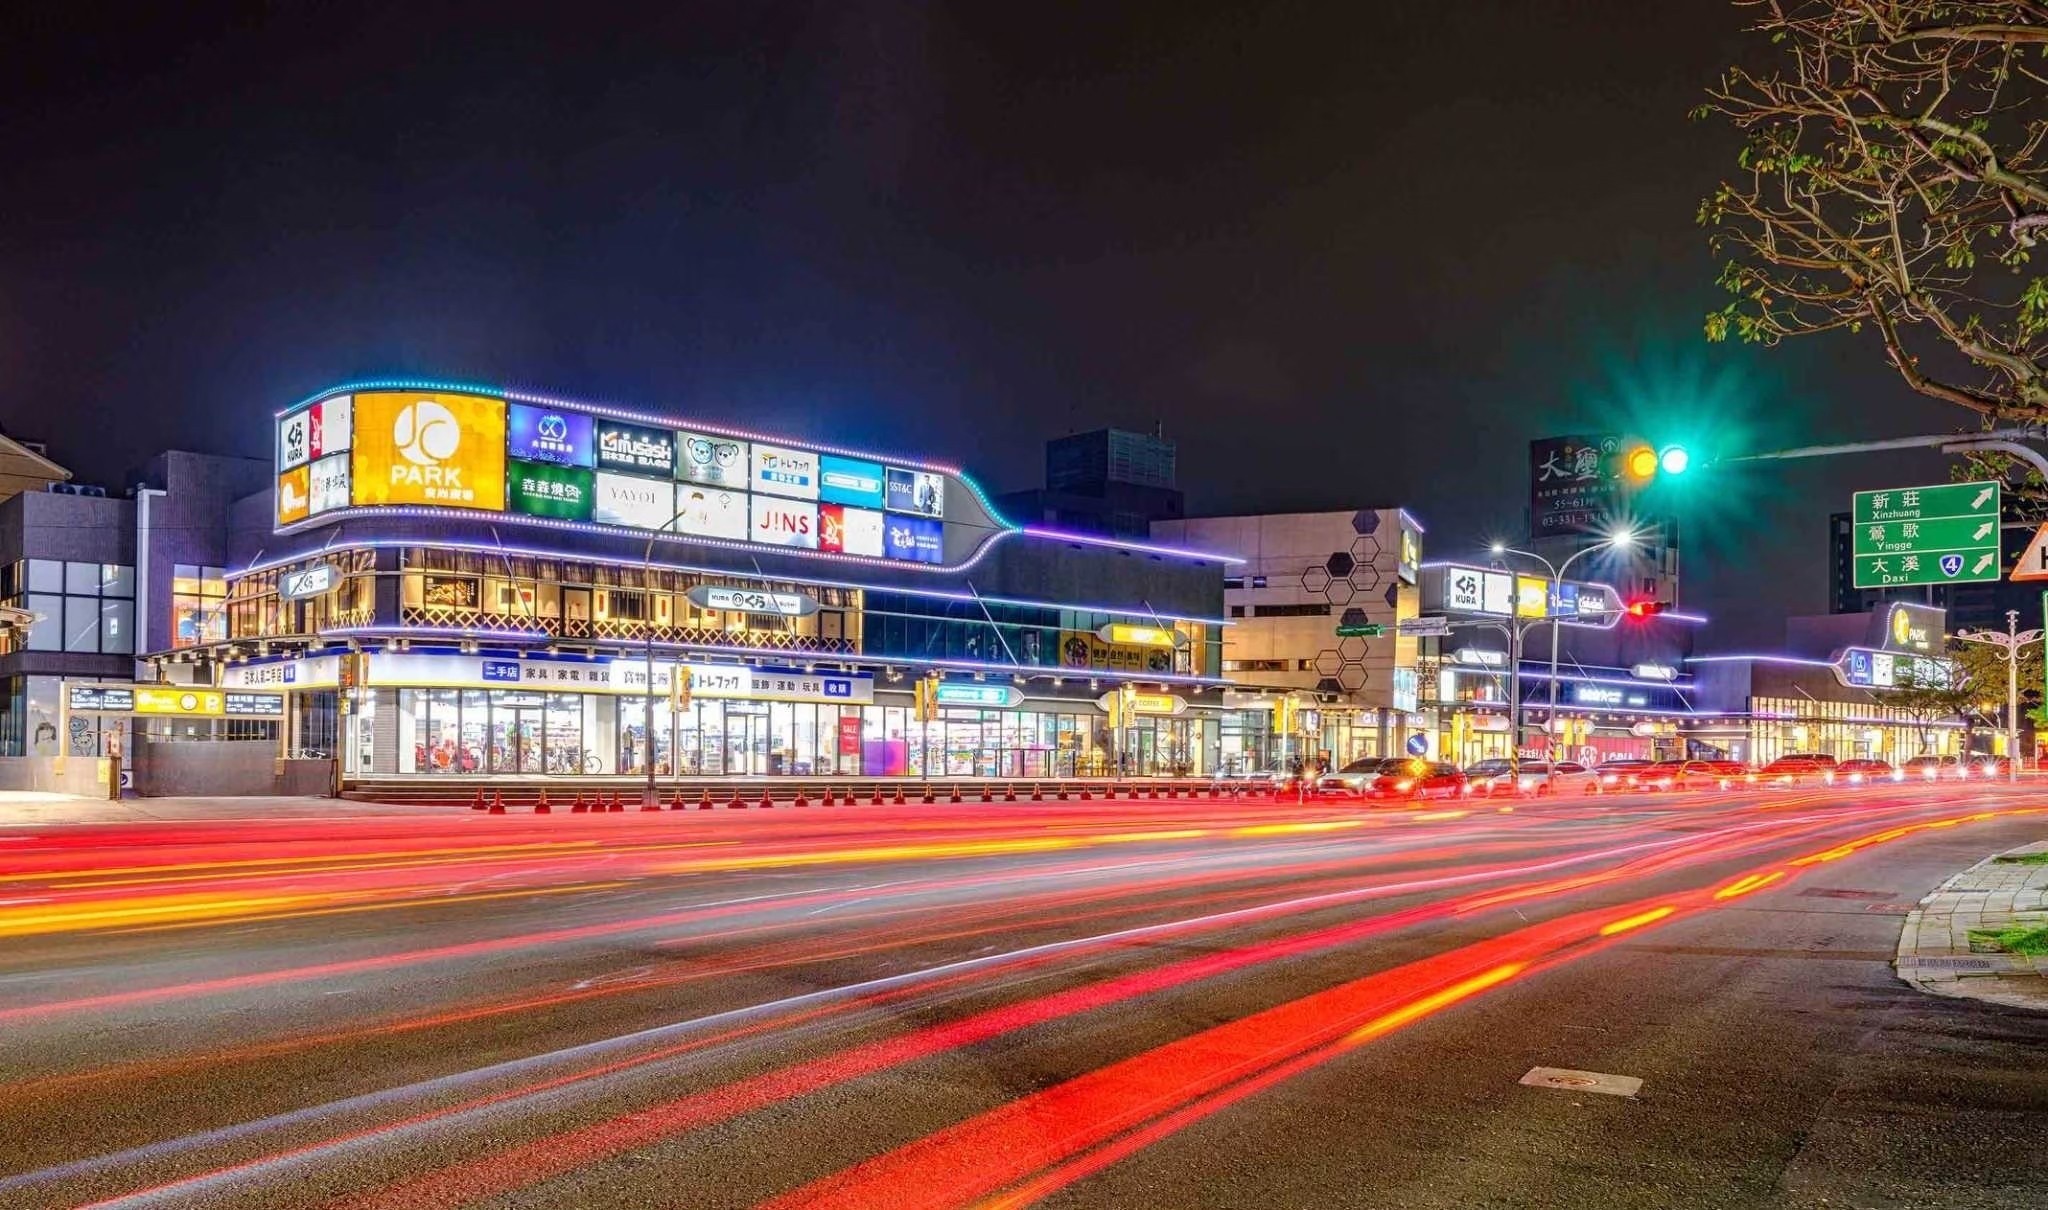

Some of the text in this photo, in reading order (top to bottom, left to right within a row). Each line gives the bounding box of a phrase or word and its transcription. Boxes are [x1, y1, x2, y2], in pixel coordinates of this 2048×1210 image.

[391, 464, 462, 487] PARK
[610, 487, 656, 505] YAYOI
[1872, 491, 1920, 510] 新莊
[1872, 509, 1921, 520] Xinzhuang
[1868, 523, 1919, 542] 鶯歌
[1877, 541, 1913, 551] Yingge
[1872, 555, 1920, 574] 大溪
[1945, 557, 1958, 572] 4
[1455, 576, 1476, 595] くら
[1882, 574, 1909, 584] Daxi
[745, 594, 766, 609] くら
[1455, 594, 1477, 605] KURA
[1908, 628, 1927, 641] PARK
[485, 666, 518, 678] 二手店
[525, 668, 548, 680] 家具
[557, 669, 580, 681] 家電
